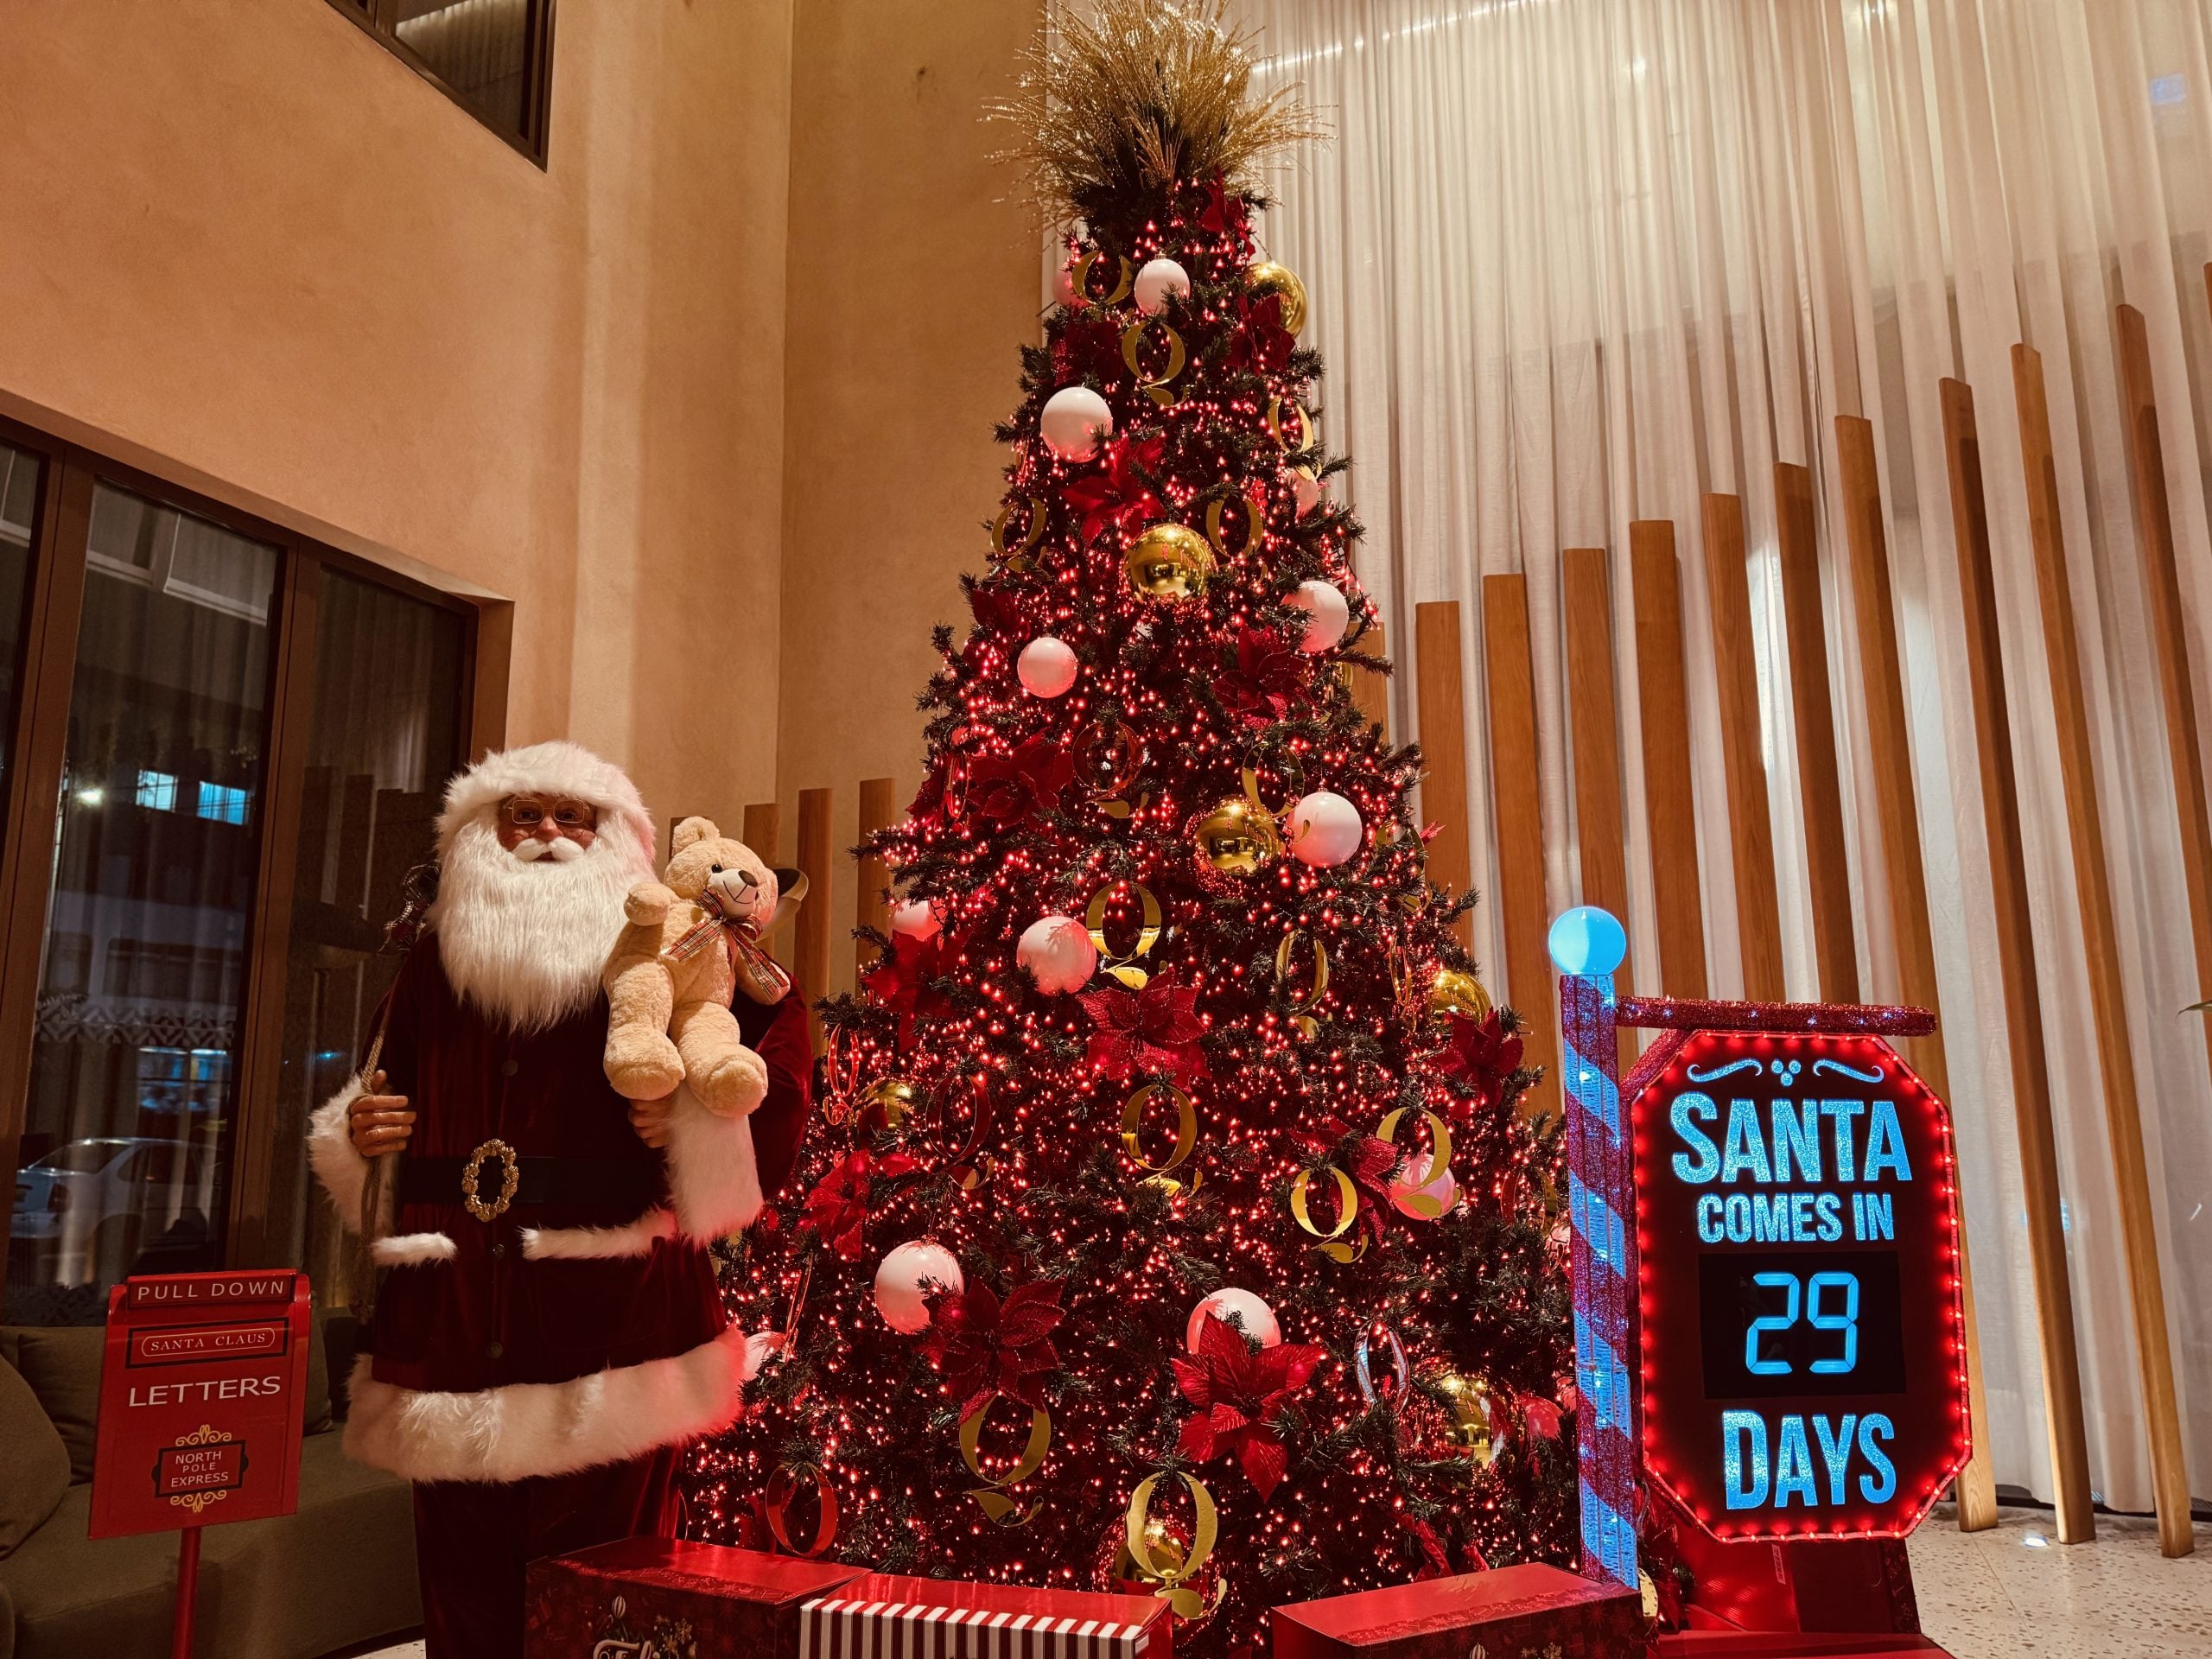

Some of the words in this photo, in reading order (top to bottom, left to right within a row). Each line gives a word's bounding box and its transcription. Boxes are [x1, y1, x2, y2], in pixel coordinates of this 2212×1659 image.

[1669, 1090, 1912, 1185] SANTA
[1697, 1192, 1843, 1243] COMES
[1853, 1193, 1895, 1242] IN
[138, 1284, 198, 1300] PULL
[211, 1281, 283, 1296] DOWN
[1745, 1271, 1860, 1375] 29
[151, 1338, 204, 1351] SANTA
[215, 1333, 265, 1346] CLAUS
[130, 1376, 281, 1407] LETTERS
[175, 1451, 221, 1465] NORTH
[182, 1463, 216, 1472] POLE
[1722, 1409, 1897, 1510] DAYS
[171, 1472, 228, 1487] EXPRESS
